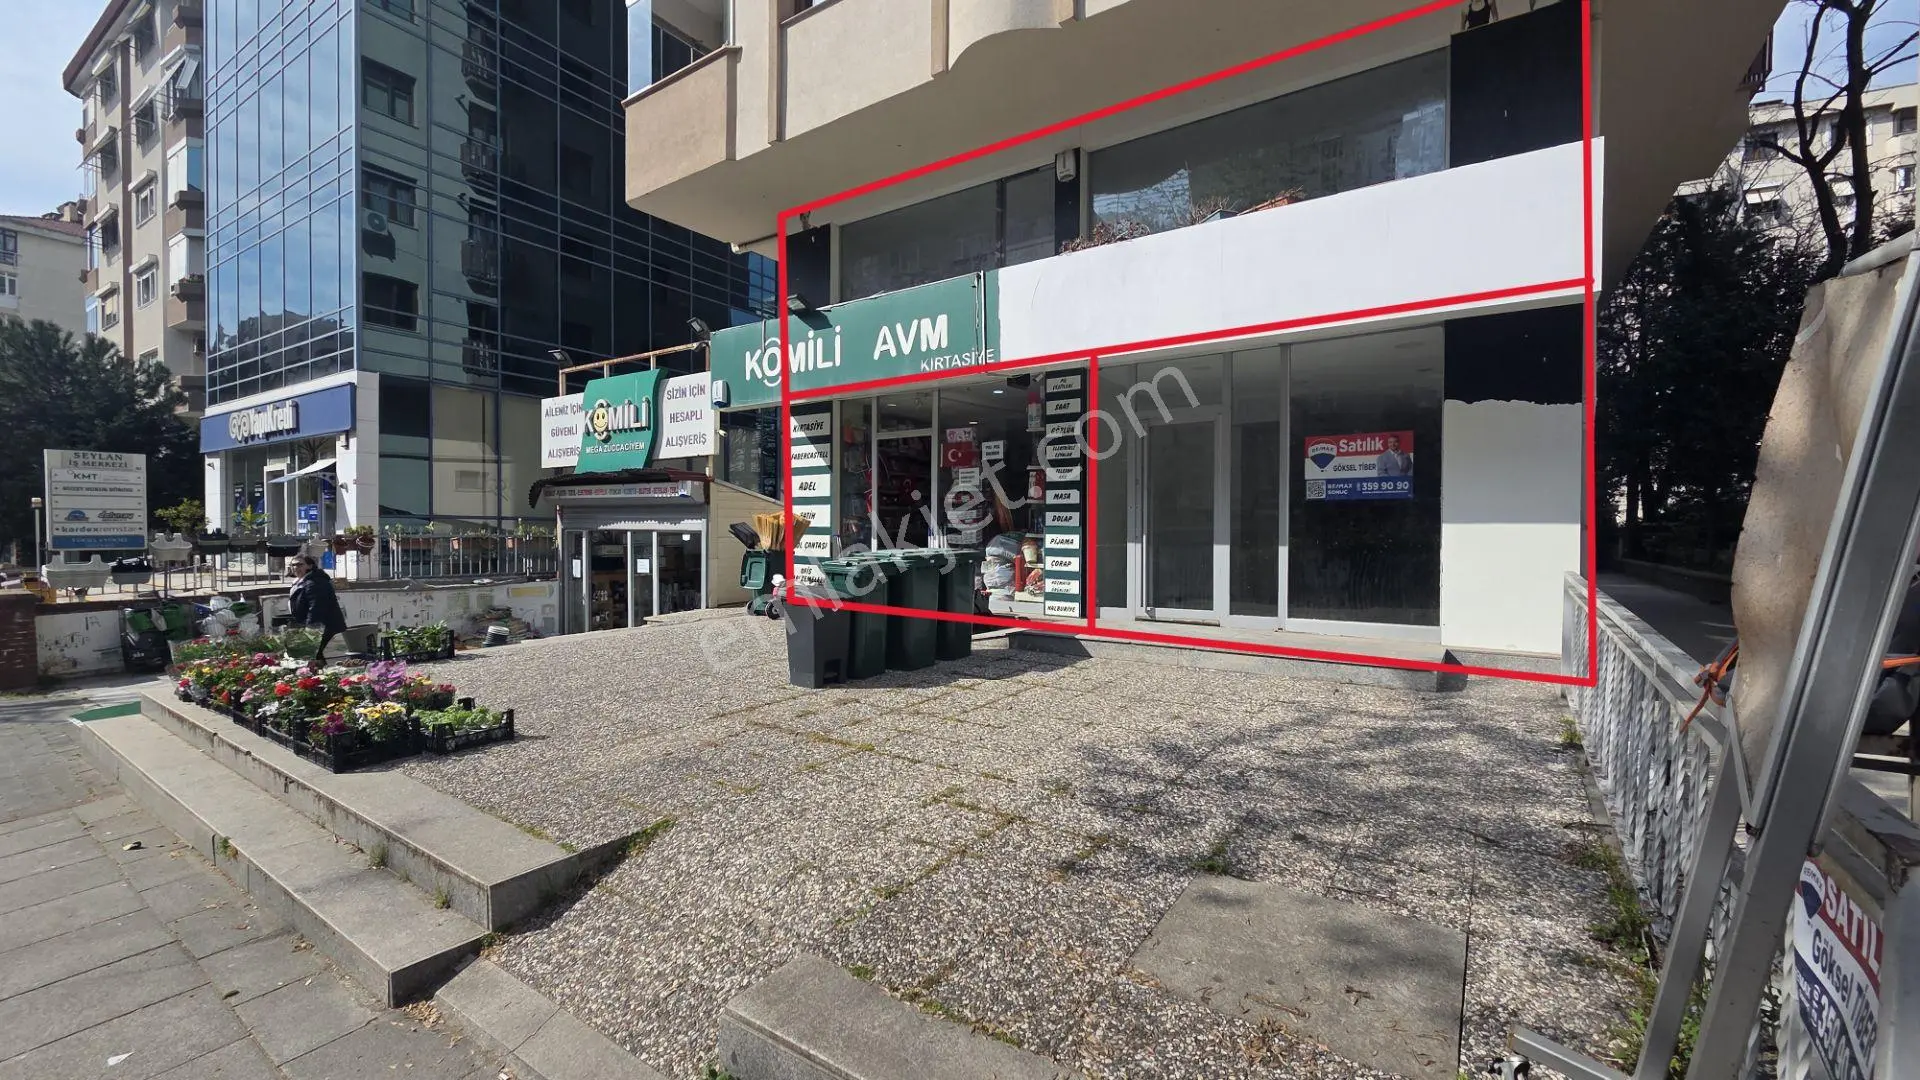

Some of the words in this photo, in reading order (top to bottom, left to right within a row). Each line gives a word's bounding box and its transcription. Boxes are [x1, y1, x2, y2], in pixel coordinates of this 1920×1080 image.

[745, 325, 841, 386] KOMİLİ
[873, 314, 948, 361] AVM
[920, 347, 995, 372] KIRTASİYE
[666, 386, 687, 400] SİZİN
[689, 384, 706, 398] İÇİN
[669, 409, 703, 424] HESAPLI
[793, 420, 824, 432] KIRTASİYE
[665, 432, 707, 447] ALIŞVERİŞ
[1339, 436, 1384, 453] Satılık
[585, 446, 602, 454] MEGA
[73, 452, 123, 461] SEYLAN
[1332, 464, 1357, 472] GÖKSEL
[1359, 462, 1377, 471] TİBER
[799, 481, 817, 491] ADEL
[1361, 482, 1379, 491] 359
[1381, 481, 1394, 490] 90
[1396, 481, 1409, 490] 90
[1052, 515, 1073, 523] DOLAP
[1049, 536, 1075, 546] PİJAMA
[1812, 928, 1854, 1009] Göksel
